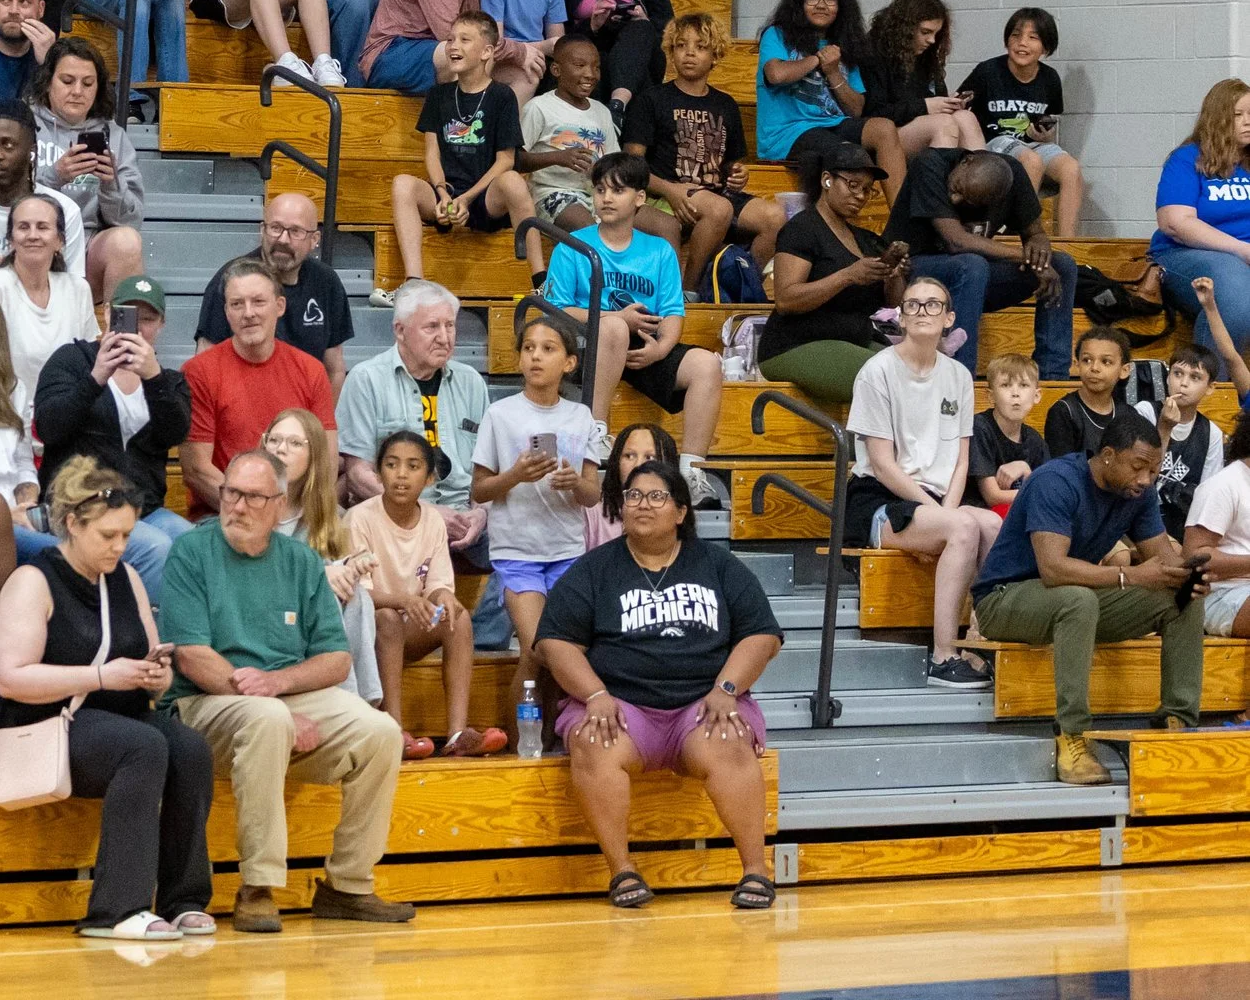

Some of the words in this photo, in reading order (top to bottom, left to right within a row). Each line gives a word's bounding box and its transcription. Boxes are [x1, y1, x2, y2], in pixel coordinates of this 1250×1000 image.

[673, 109, 709, 123] PEACE
[620, 583, 718, 612] WESTERN
[621, 600, 719, 632] MICHIGAN
